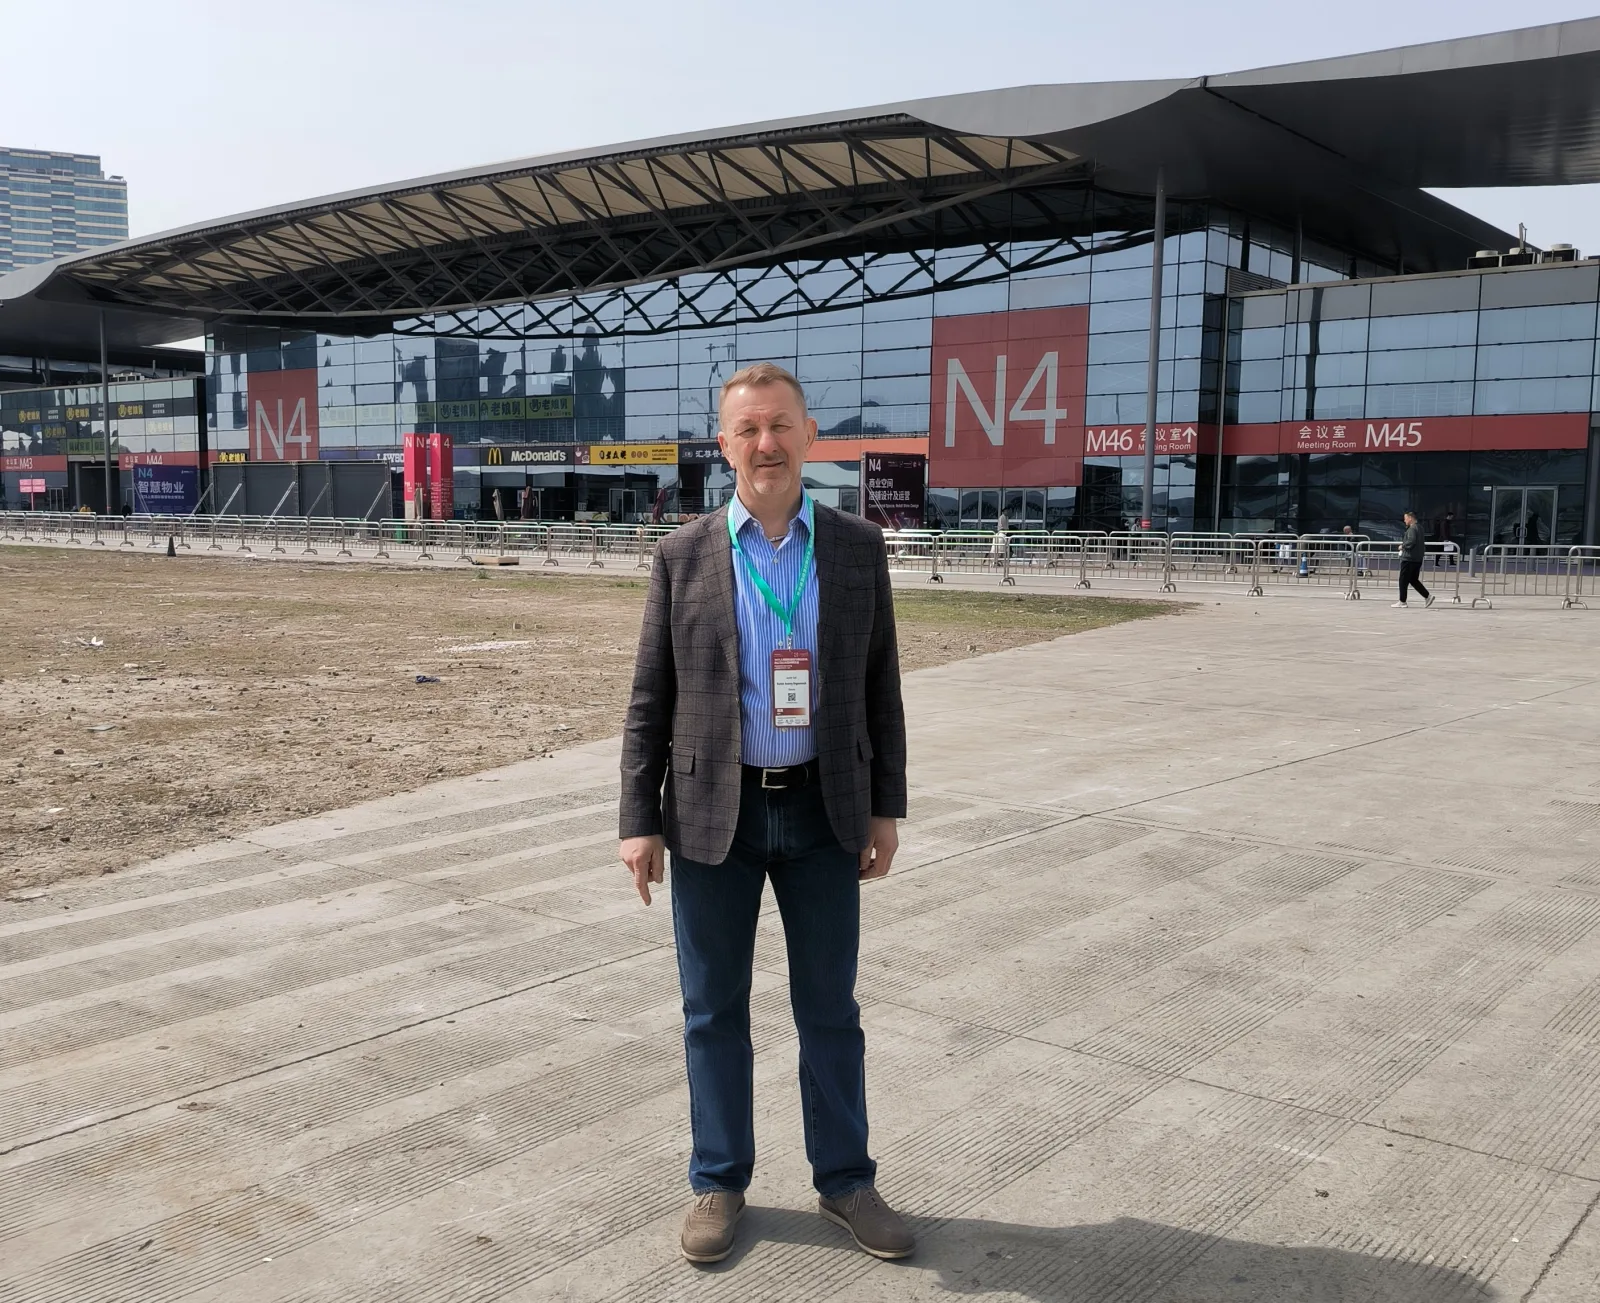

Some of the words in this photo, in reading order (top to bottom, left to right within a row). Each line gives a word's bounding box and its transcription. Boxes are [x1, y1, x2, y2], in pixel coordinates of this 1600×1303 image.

[945, 351, 1068, 447] N4
[255, 397, 312, 460] N4
[1299, 425, 1346, 439] 会议室
[1365, 422, 1423, 448] M45
[1086, 429, 1133, 452] M46
[1169, 442, 1191, 450] Room
[1297, 441, 1330, 450] Meeting
[1331, 440, 1357, 449] Room
[510, 449, 567, 462] McDonald's
[20, 457, 33, 470] M43
[869, 459, 881, 471] N4
[138, 467, 153, 479] N4
[138, 481, 185, 494] 智慧物业
